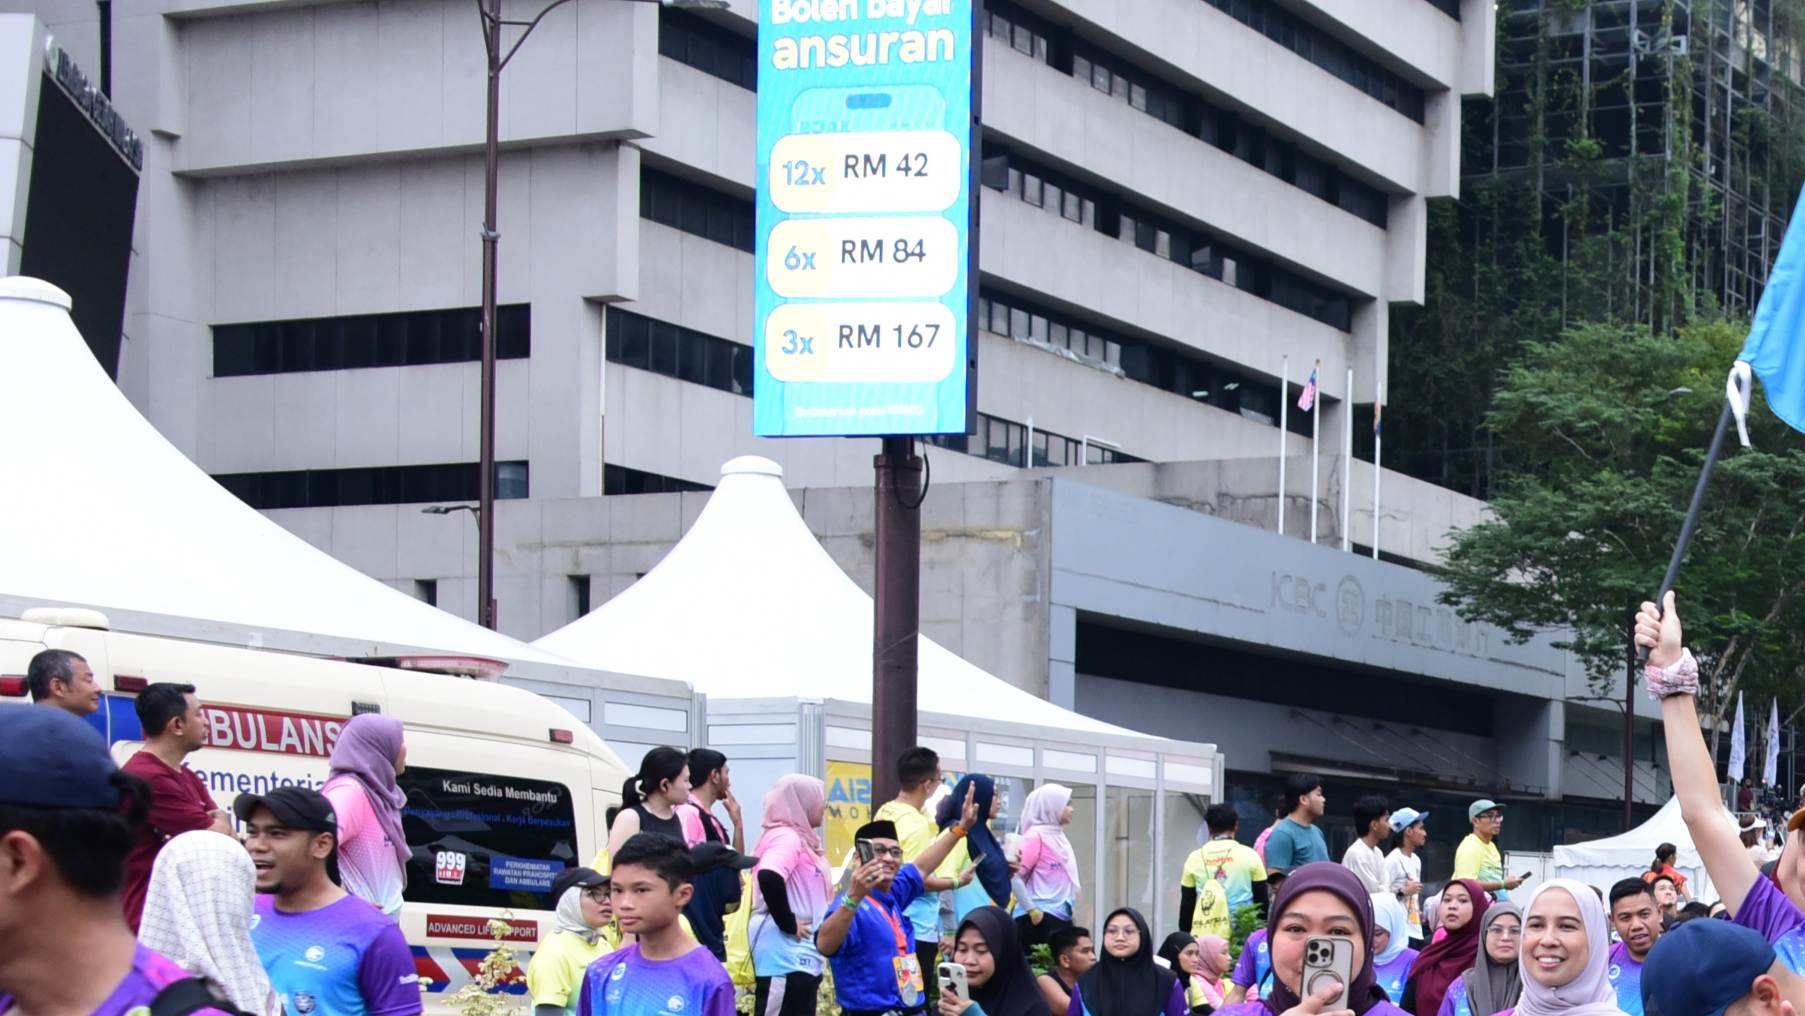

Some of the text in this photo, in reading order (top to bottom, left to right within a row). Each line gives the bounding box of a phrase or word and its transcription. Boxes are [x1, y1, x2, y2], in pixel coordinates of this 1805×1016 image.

[772, 28, 955, 70] ansuran
[782, 152, 929, 187] 12x RM 42
[784, 238, 927, 271] 6x RM 84
[782, 324, 941, 355] 3x RM 167
[1271, 569, 1328, 618] ICBC
[443, 780, 558, 804] Kami Sedia Membantu
[436, 851, 466, 870] 999
[428, 922, 476, 936] ADVANCED
